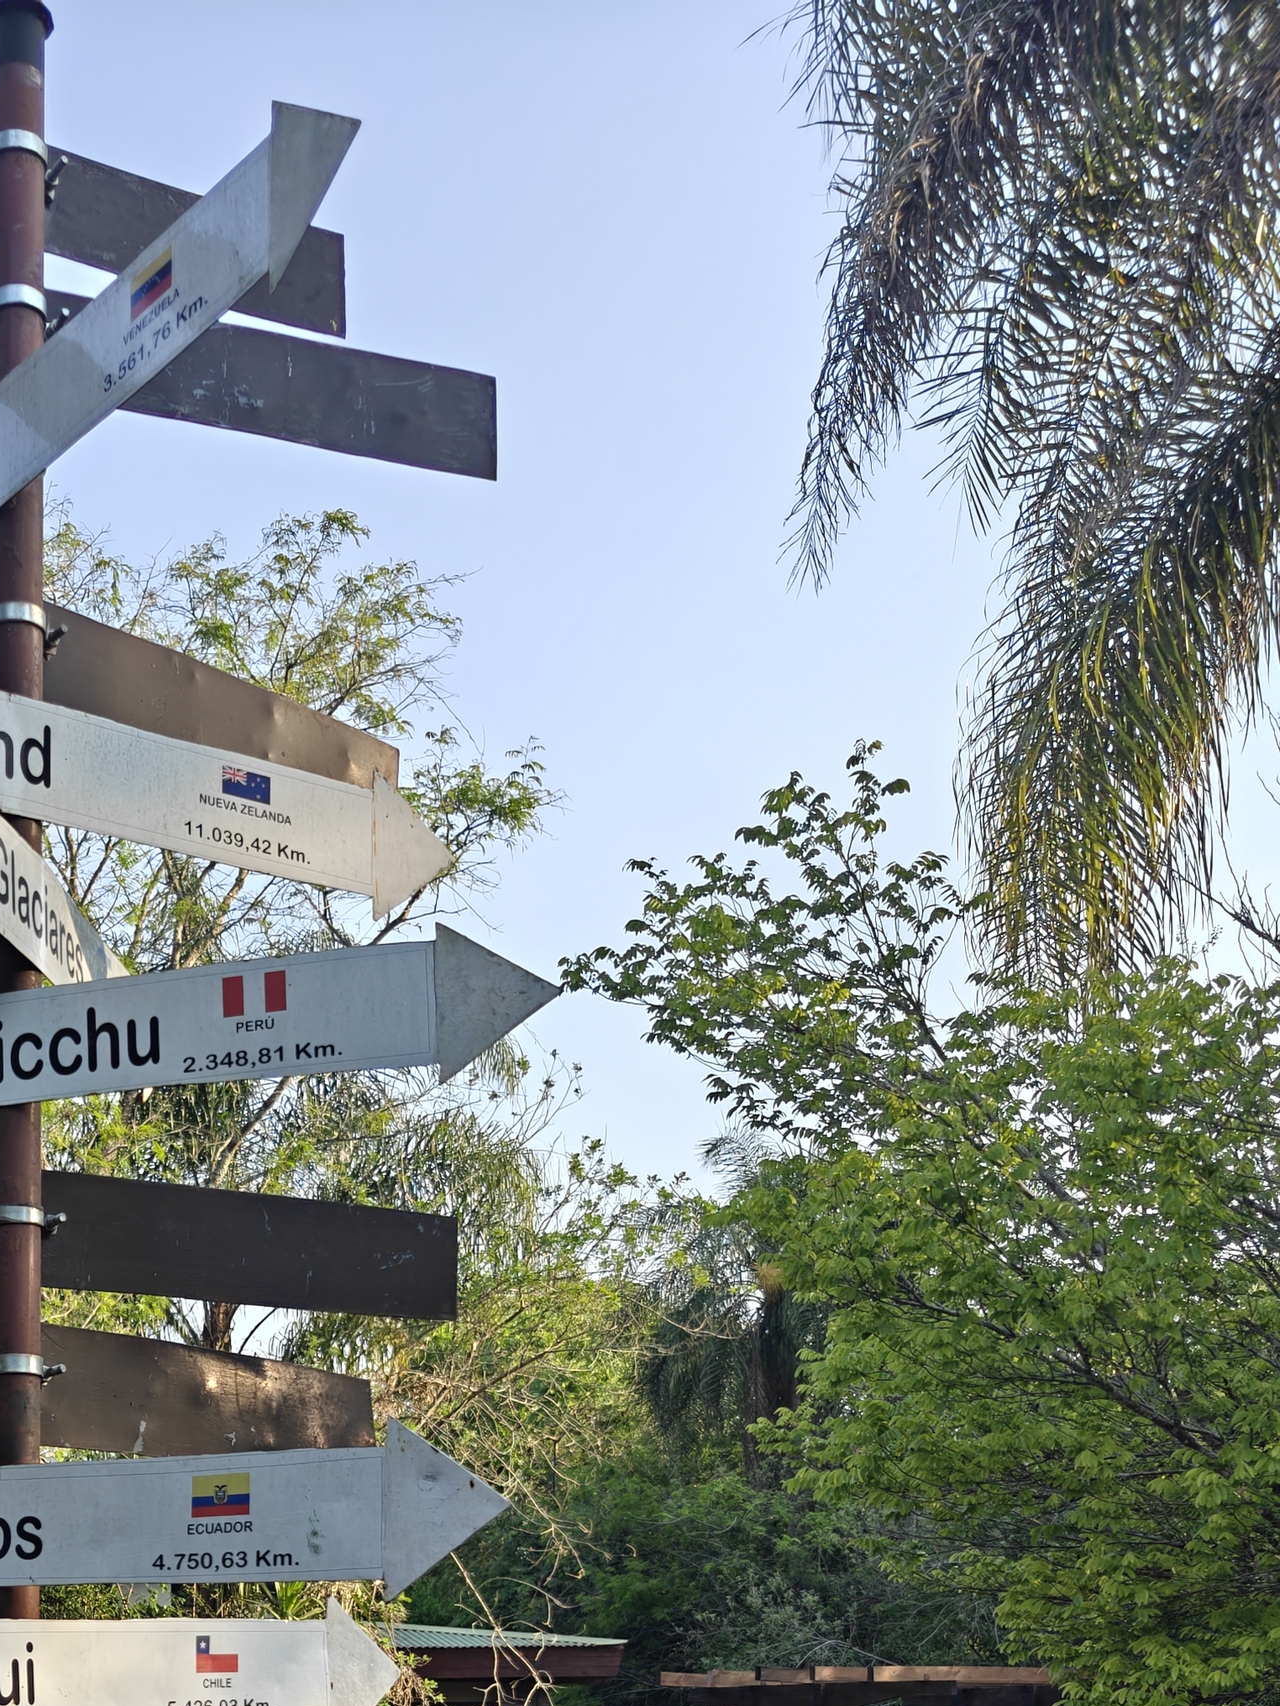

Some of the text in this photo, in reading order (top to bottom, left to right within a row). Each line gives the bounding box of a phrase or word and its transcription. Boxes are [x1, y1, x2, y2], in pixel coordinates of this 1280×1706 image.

[123, 288, 180, 345] VENEZUELA
[103, 296, 208, 393] 3.561,76 Km.
[199, 793, 292, 826] NUEVA ZELANDA
[184, 820, 311, 865] 11.039,42 Km.
[236, 1015, 275, 1033] PERÚ
[183, 1042, 342, 1073] 2.348,81 Km.
[187, 1520, 253, 1535] ECUADOR
[152, 1550, 300, 1572] 4.750,63 Km.
[202, 1678, 232, 1689] CHILE
